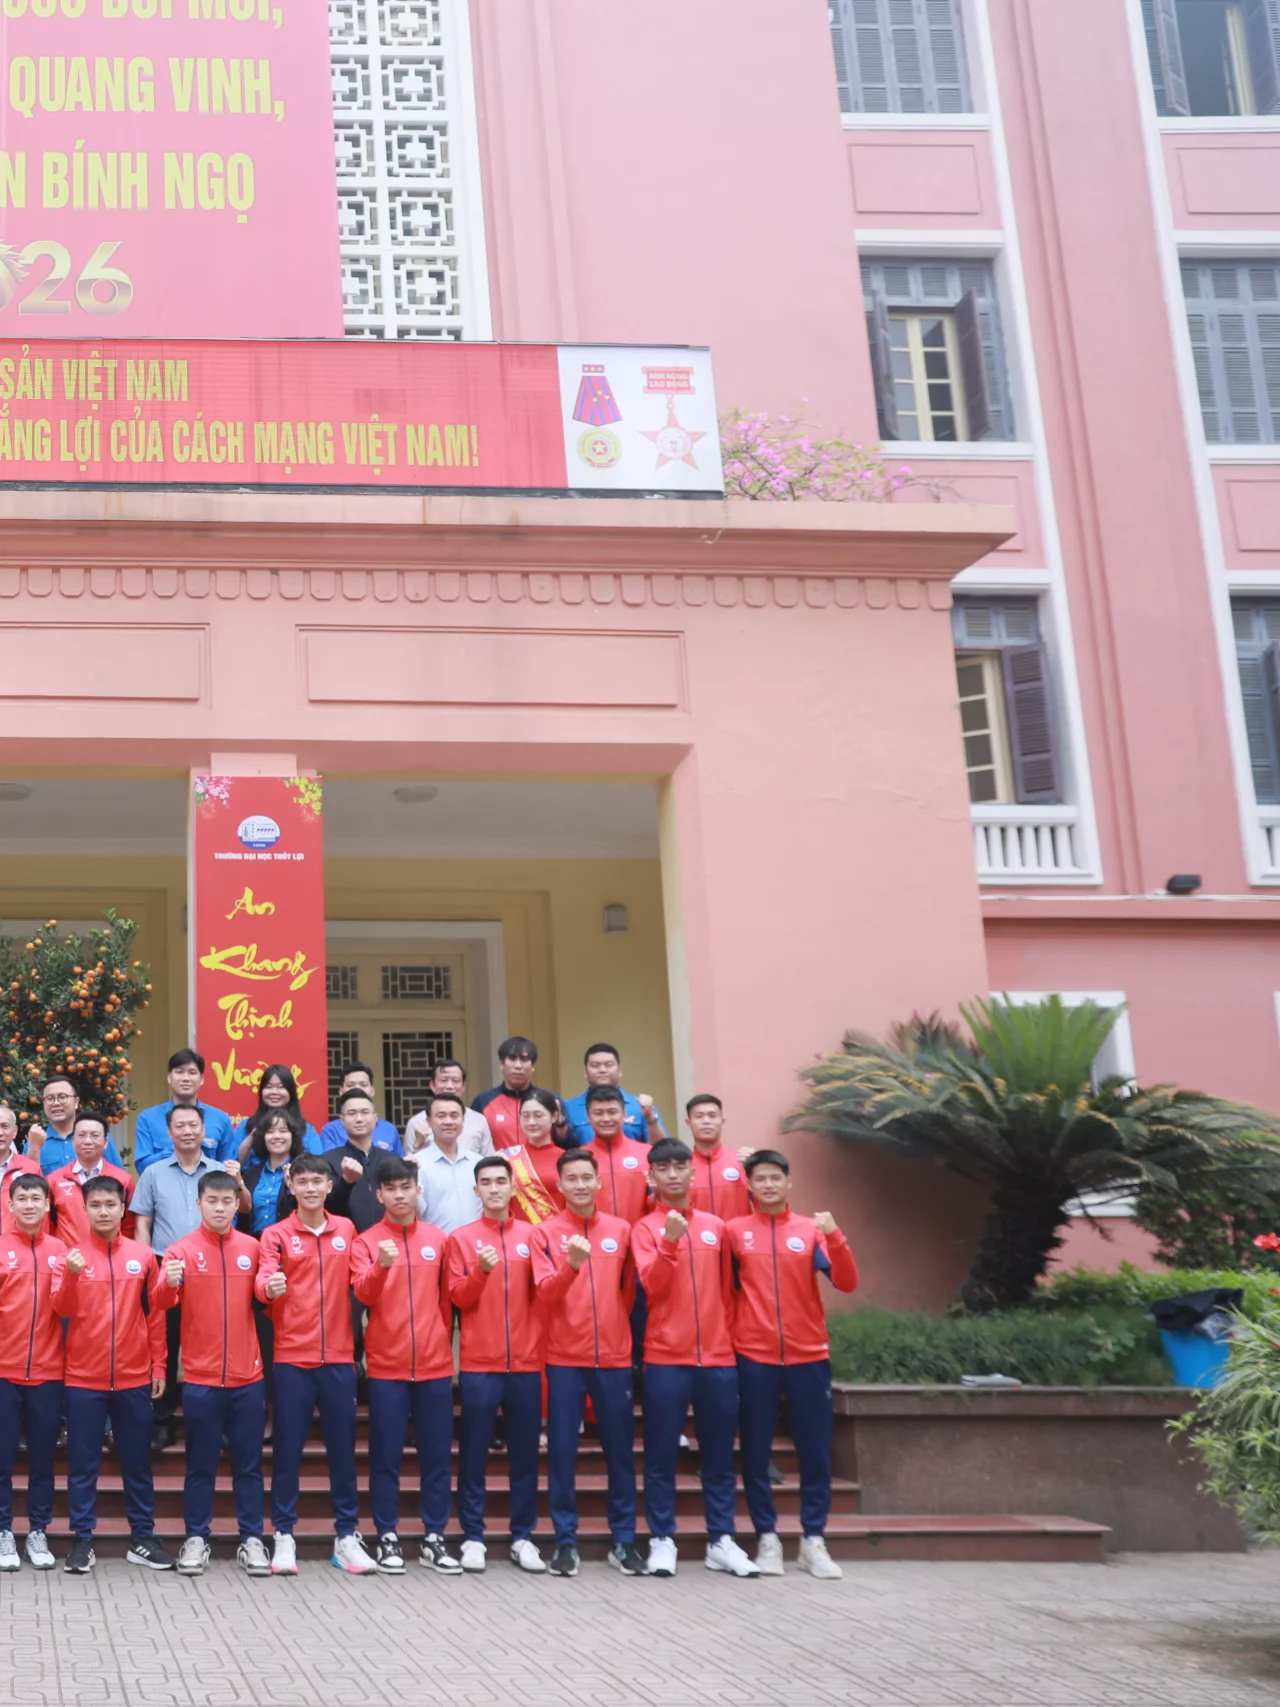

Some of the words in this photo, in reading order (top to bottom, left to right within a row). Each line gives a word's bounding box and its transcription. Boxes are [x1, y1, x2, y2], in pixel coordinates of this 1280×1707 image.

[9, 55, 155, 118] QUANG
[168, 57, 285, 121] VINH,
[42, 139, 148, 209] BÍNH
[163, 152, 255, 223] NGỌ
[62, 351, 118, 410] VIỆT
[126, 359, 189, 401] NAM
[59, 415, 102, 472] LỢI
[110, 405, 165, 463] CỦA
[173, 411, 245, 463] CÁCH
[254, 421, 335, 474] MẠNG
[342, 414, 399, 475] VIỆT
[406, 424, 479, 467] NAM!
[225, 887, 276, 920] An
[199, 943, 320, 990] Khang
[217, 993, 293, 1040] Thịnh
